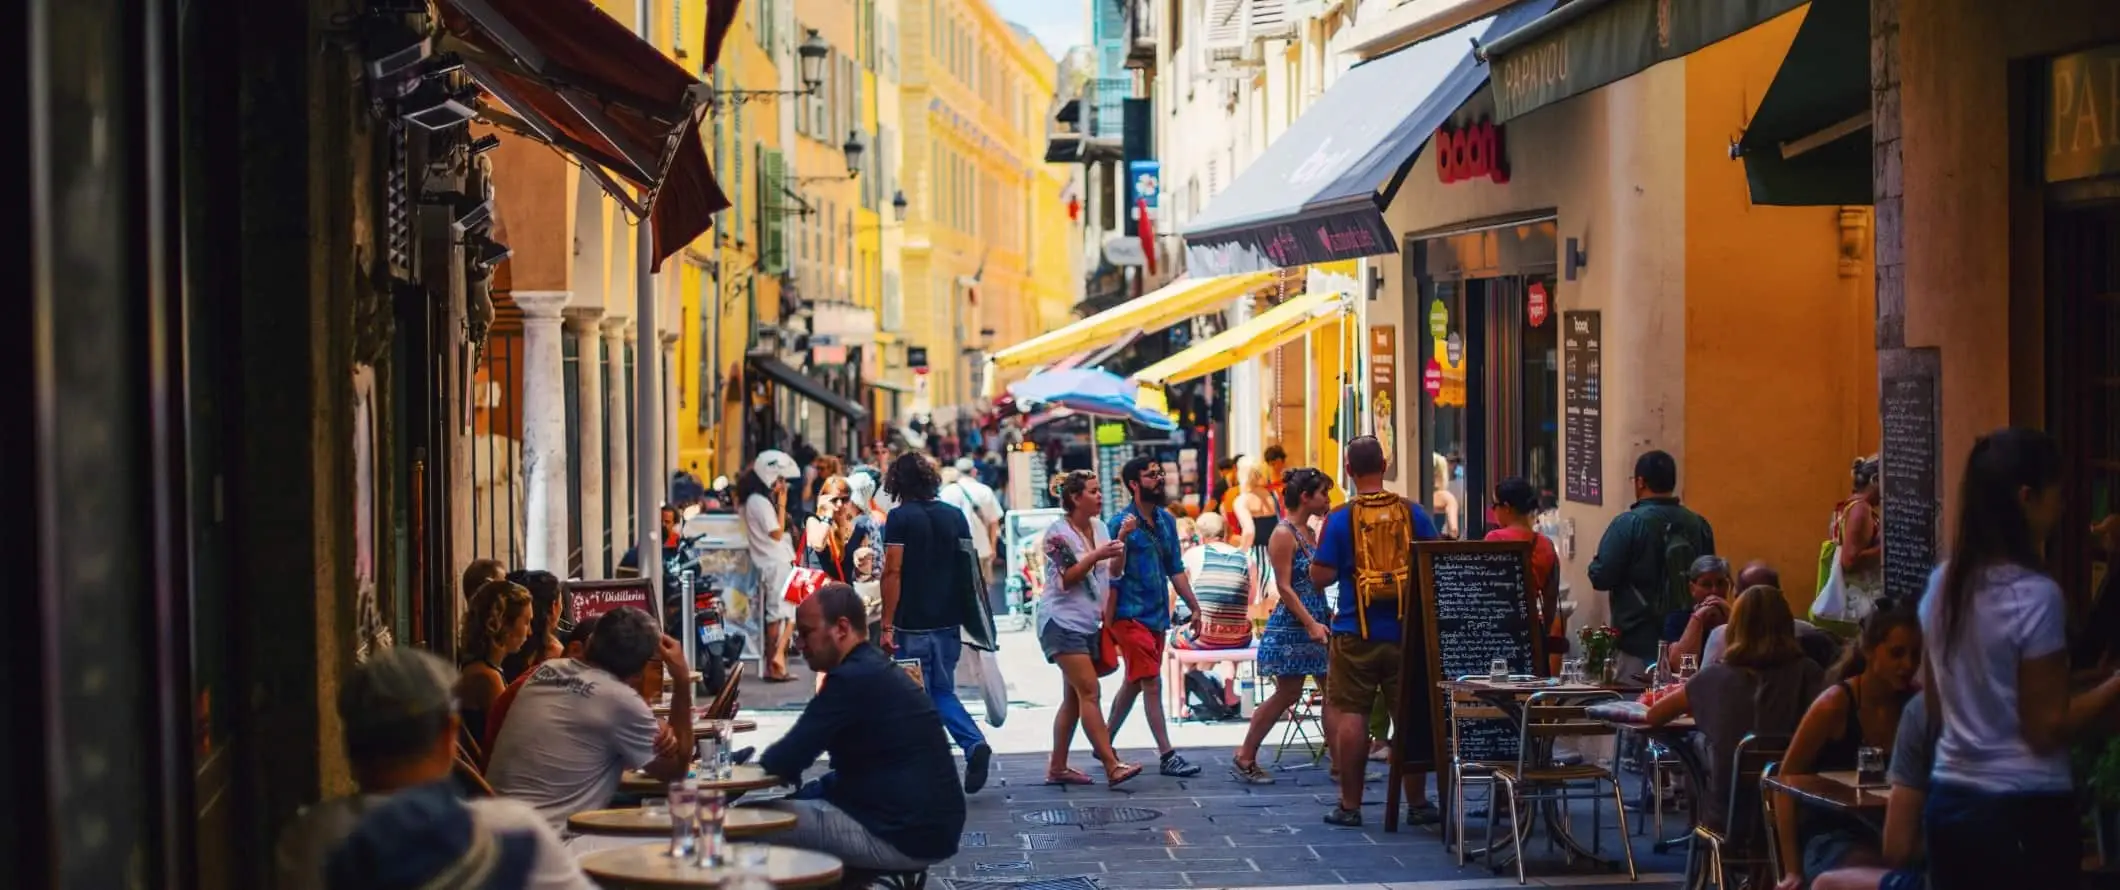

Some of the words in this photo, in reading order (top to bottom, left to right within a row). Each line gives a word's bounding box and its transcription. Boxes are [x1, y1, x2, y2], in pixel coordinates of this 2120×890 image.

[1505, 36, 1569, 99] PAPAYOU
[2052, 61, 2120, 155] PA
[602, 589, 646, 602] Distilleries
